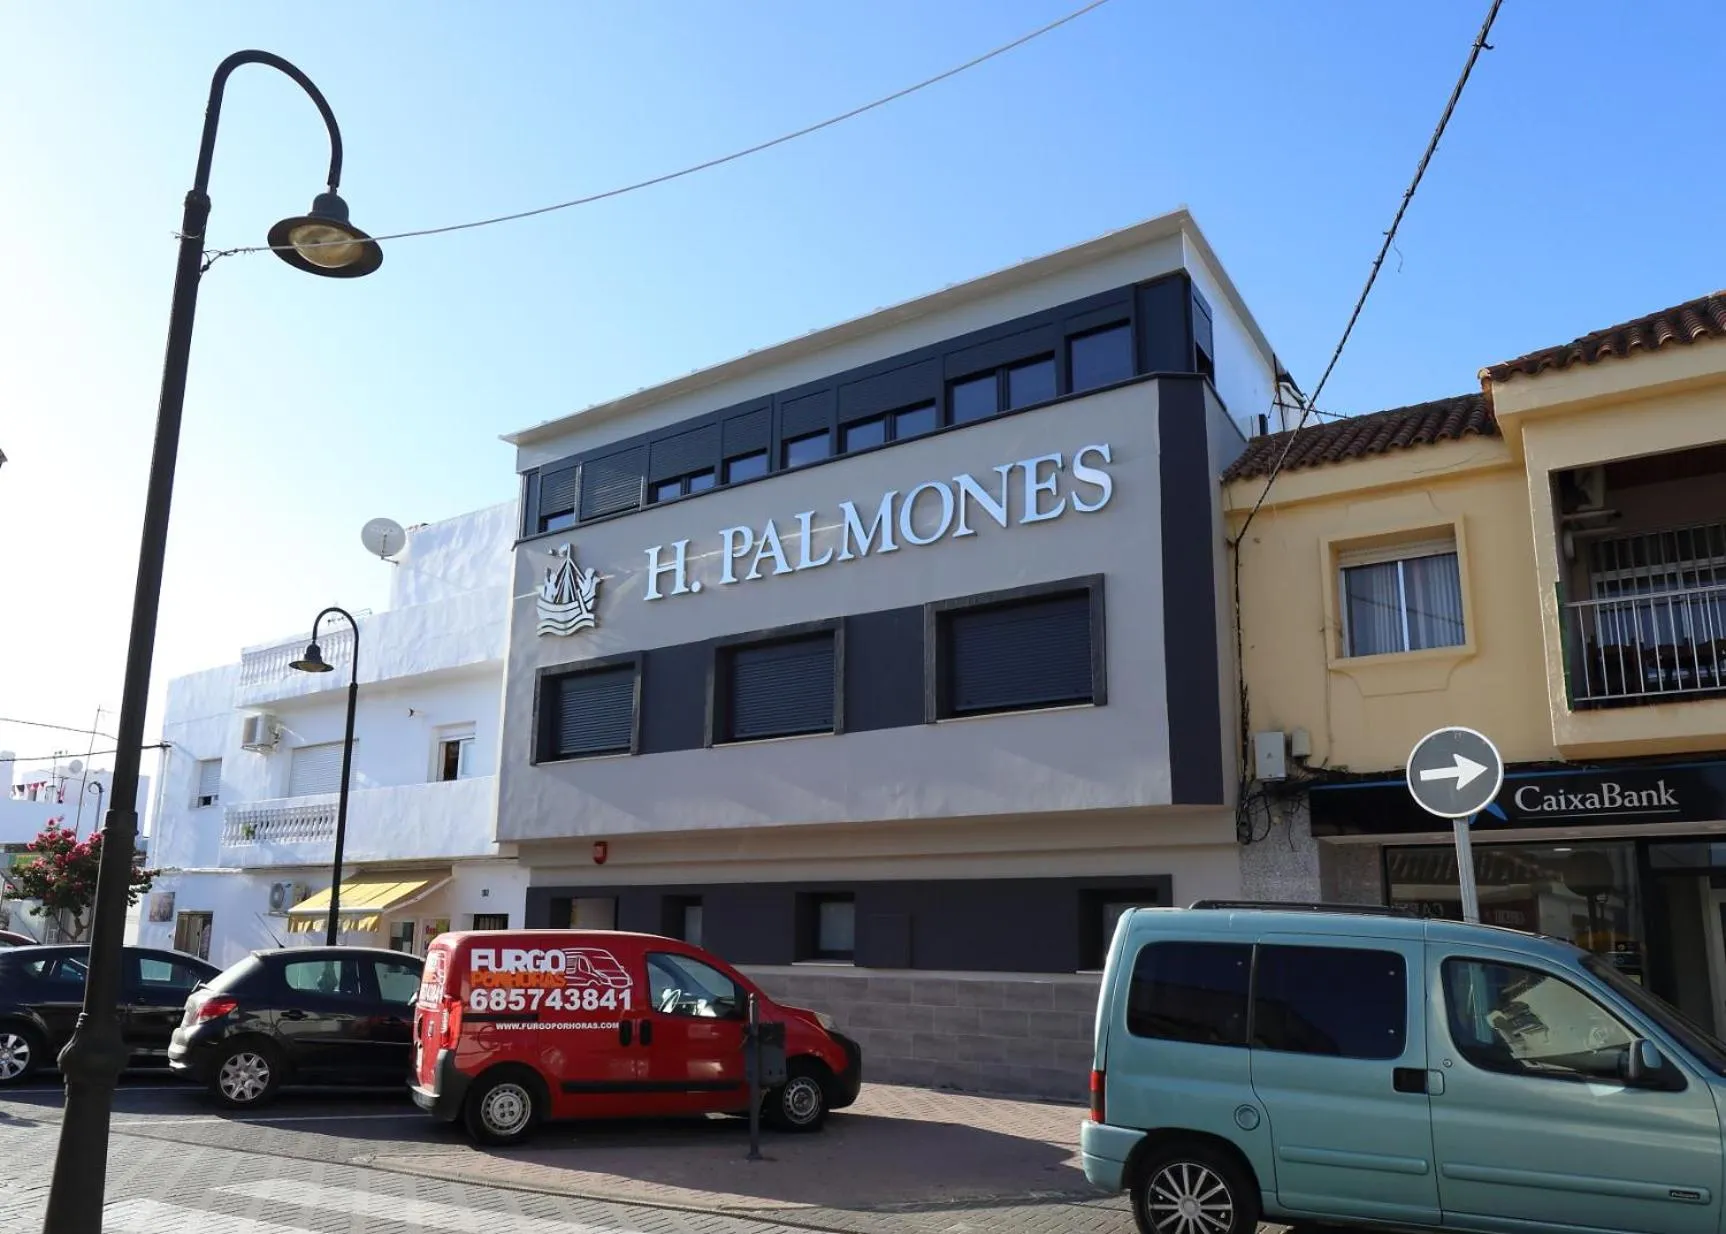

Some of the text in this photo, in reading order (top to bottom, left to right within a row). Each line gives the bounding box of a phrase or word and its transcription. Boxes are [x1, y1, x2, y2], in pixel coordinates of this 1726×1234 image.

[643, 443, 1114, 601] H. PALMONES
[1514, 778, 1680, 813] CaixaBank
[470, 949, 566, 973] FURGO
[470, 988, 632, 1011] 685743841
[495, 1022, 620, 1031] WWW.FURGOPORHORAS.COM
